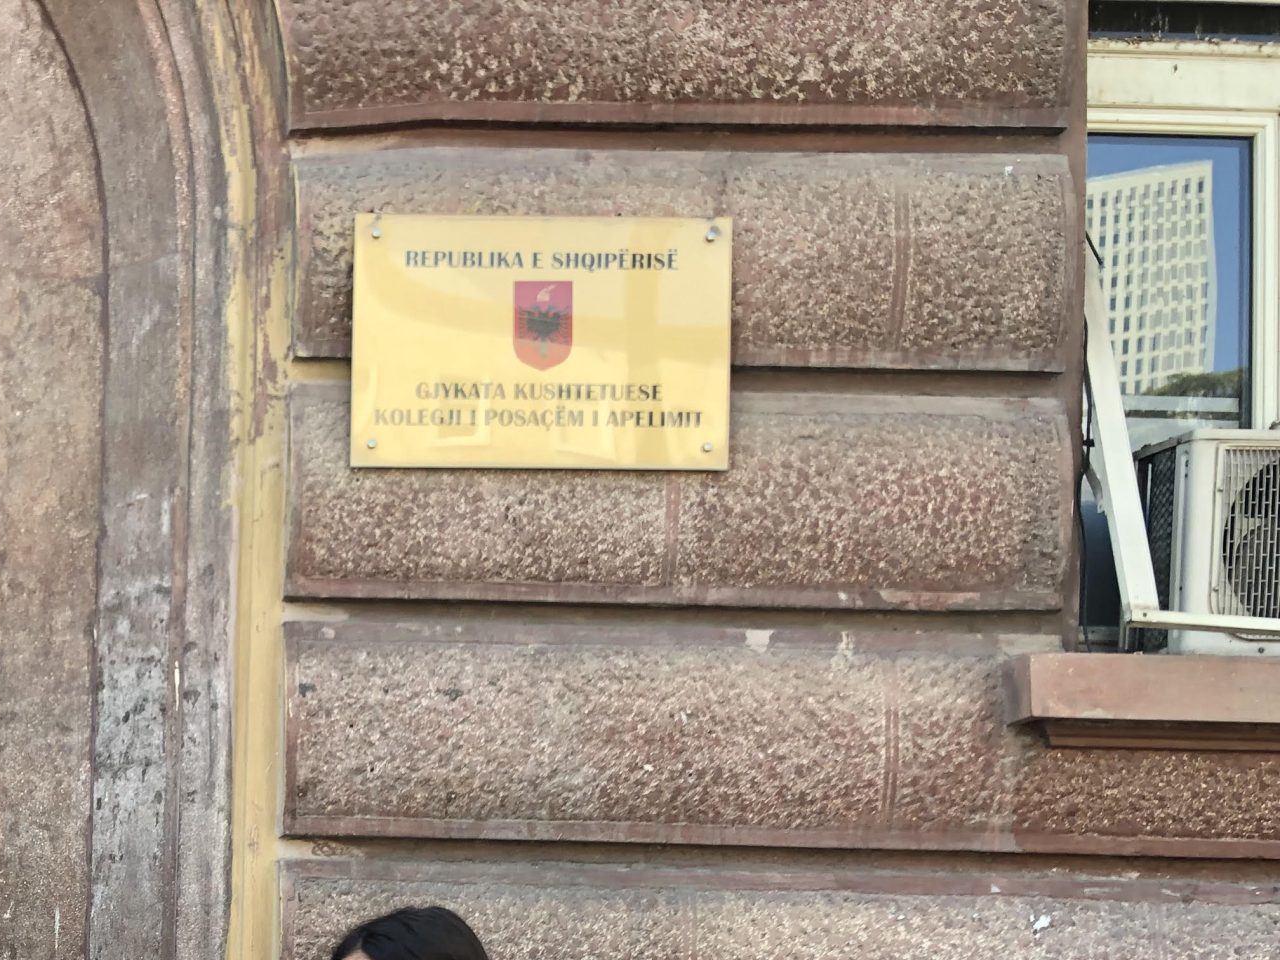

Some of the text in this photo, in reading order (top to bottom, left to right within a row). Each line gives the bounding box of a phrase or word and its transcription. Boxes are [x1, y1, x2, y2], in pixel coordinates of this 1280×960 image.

[404, 248, 679, 273] REPUBLIKA E SHQIPËRISË
[415, 382, 663, 401] GJYKATA KUSHTETUESE
[373, 405, 703, 431] KOLEGJI I POSAÇËM I APELIMIT
